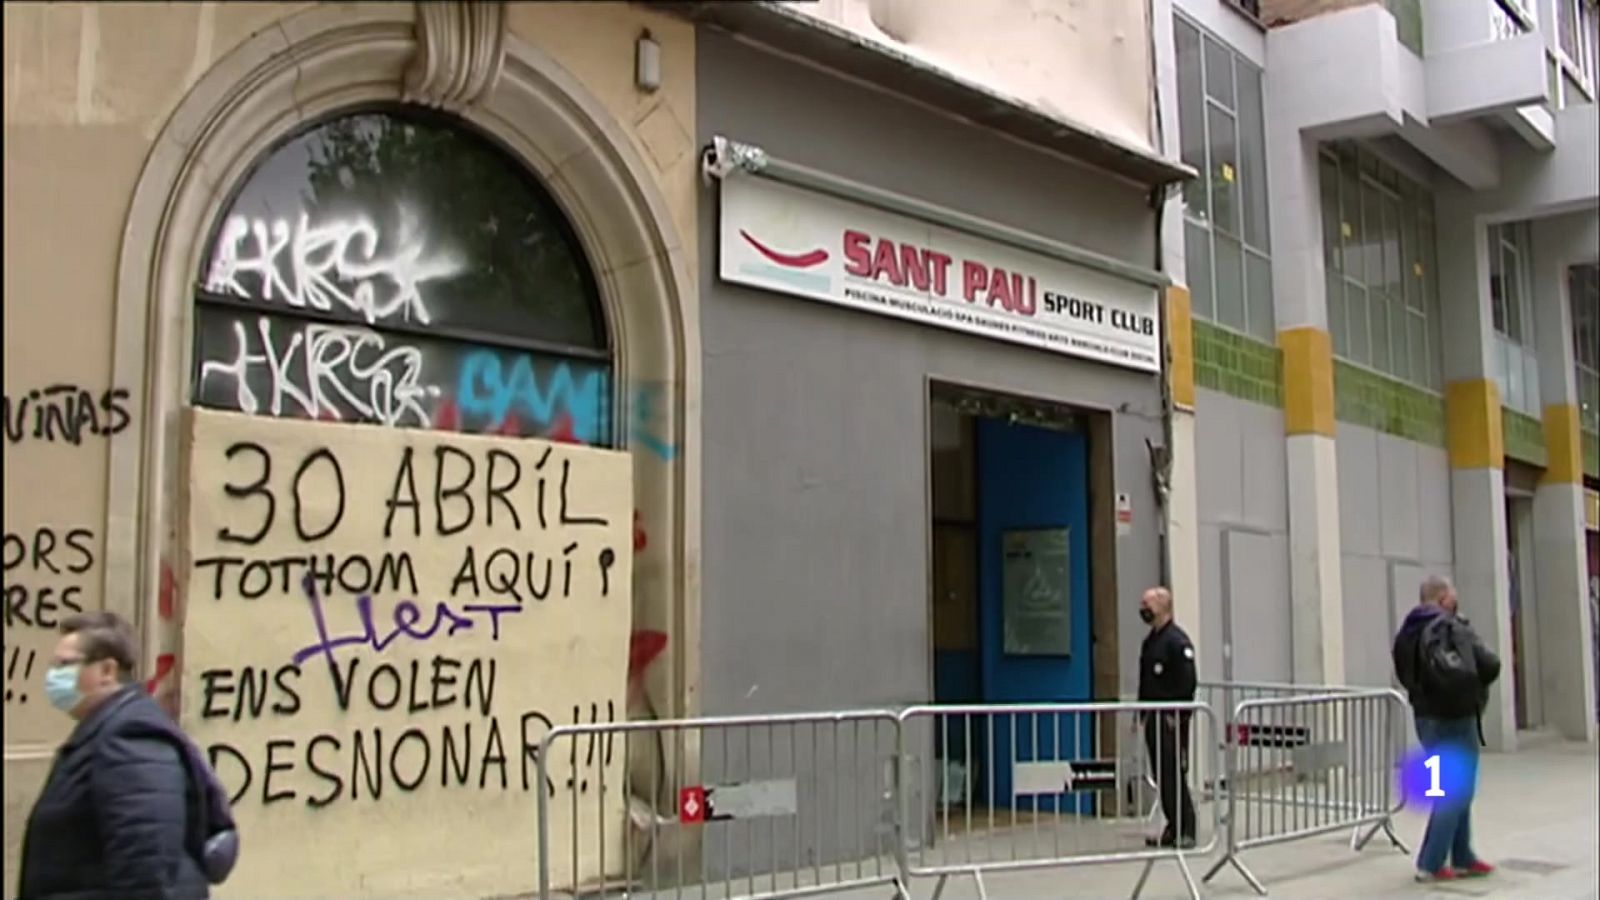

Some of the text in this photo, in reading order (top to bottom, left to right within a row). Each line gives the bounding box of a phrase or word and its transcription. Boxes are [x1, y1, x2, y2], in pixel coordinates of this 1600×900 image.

[842, 229, 1155, 337] SANT PAU SPORT CLUB
[844, 288, 887, 304] PISCINA
[955, 312, 973, 324] SPA
[217, 442, 346, 545] 30
[195, 552, 419, 600] TOTHOM
[451, 542, 578, 602] AQUÍ
[200, 656, 497, 723] ENS VOLEN
